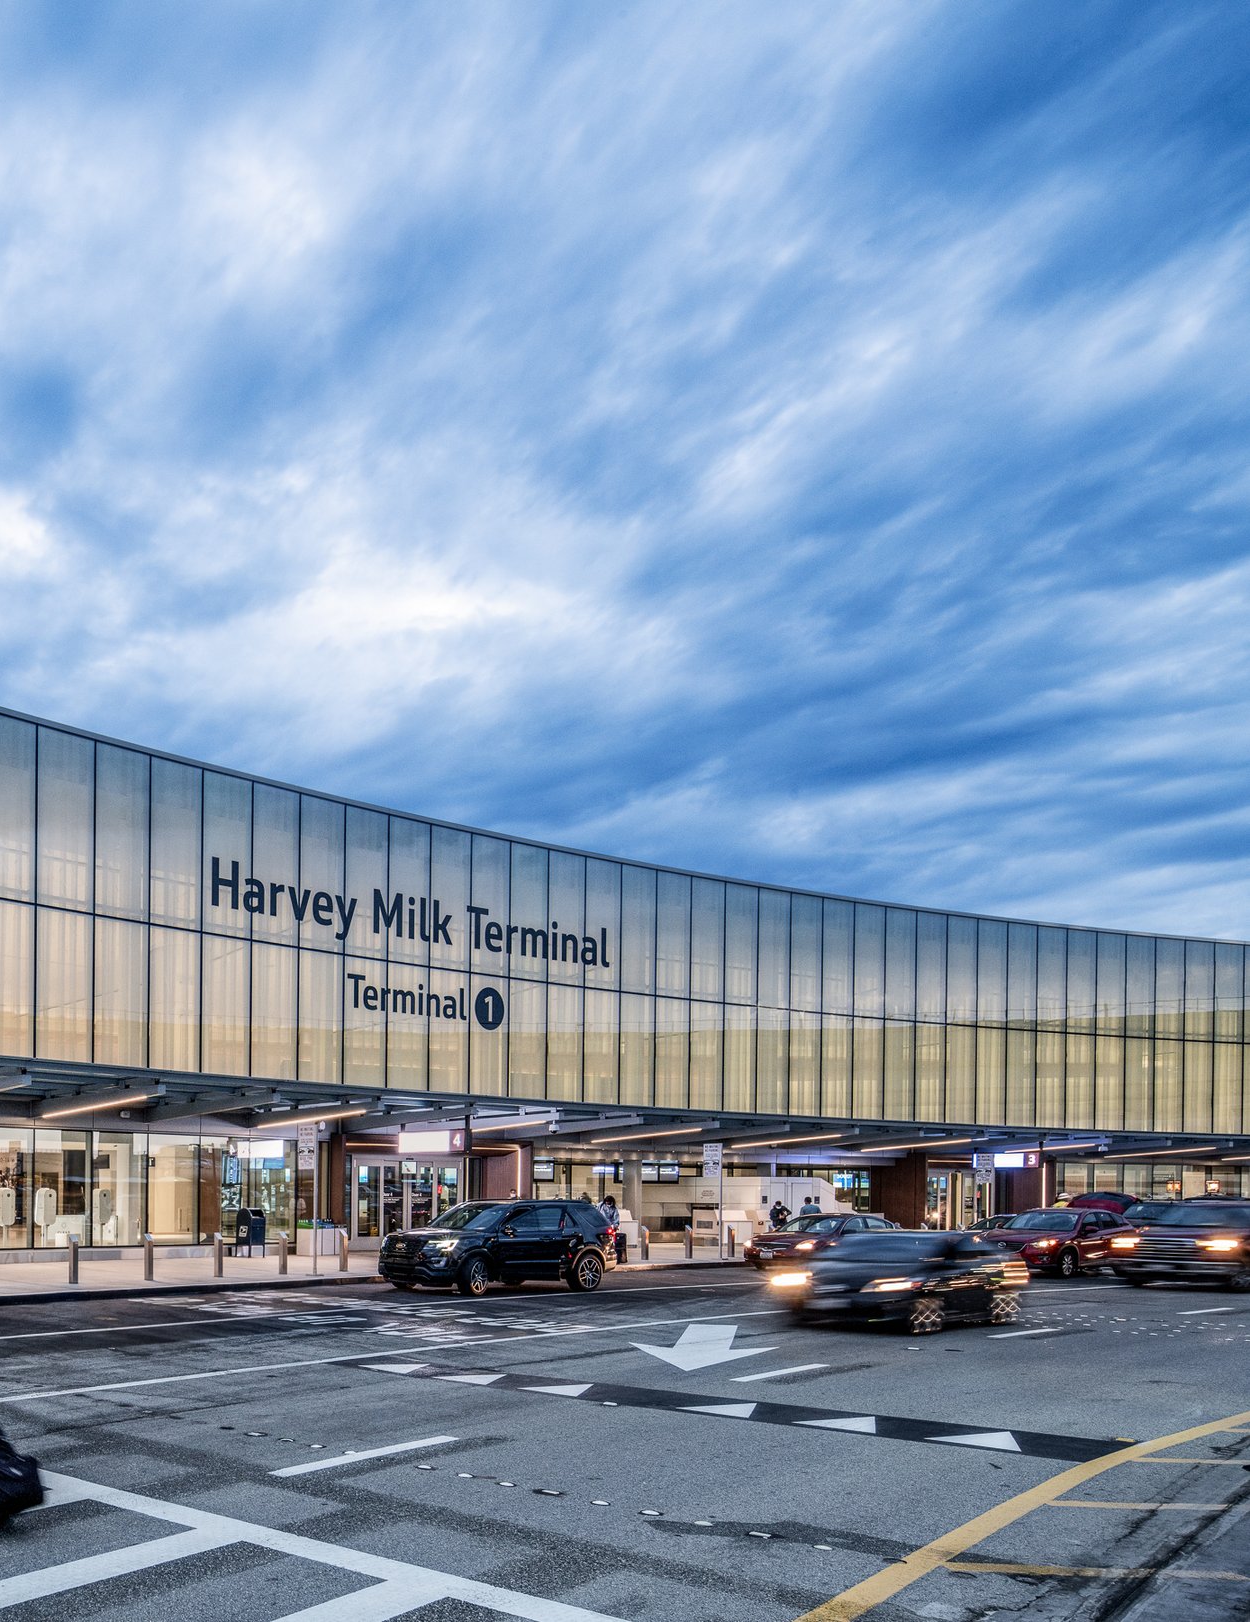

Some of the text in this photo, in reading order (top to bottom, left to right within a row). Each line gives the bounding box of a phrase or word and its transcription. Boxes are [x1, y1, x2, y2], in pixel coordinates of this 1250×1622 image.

[211, 856, 610, 968] Harvey Milk Terminal
[347, 973, 495, 1023] Terminal 1
[452, 1133, 461, 1147] 4
[1028, 1154, 1036, 1164] 3
[340, 1322, 494, 1342] PICK
[455, 1317, 596, 1333] DROP
